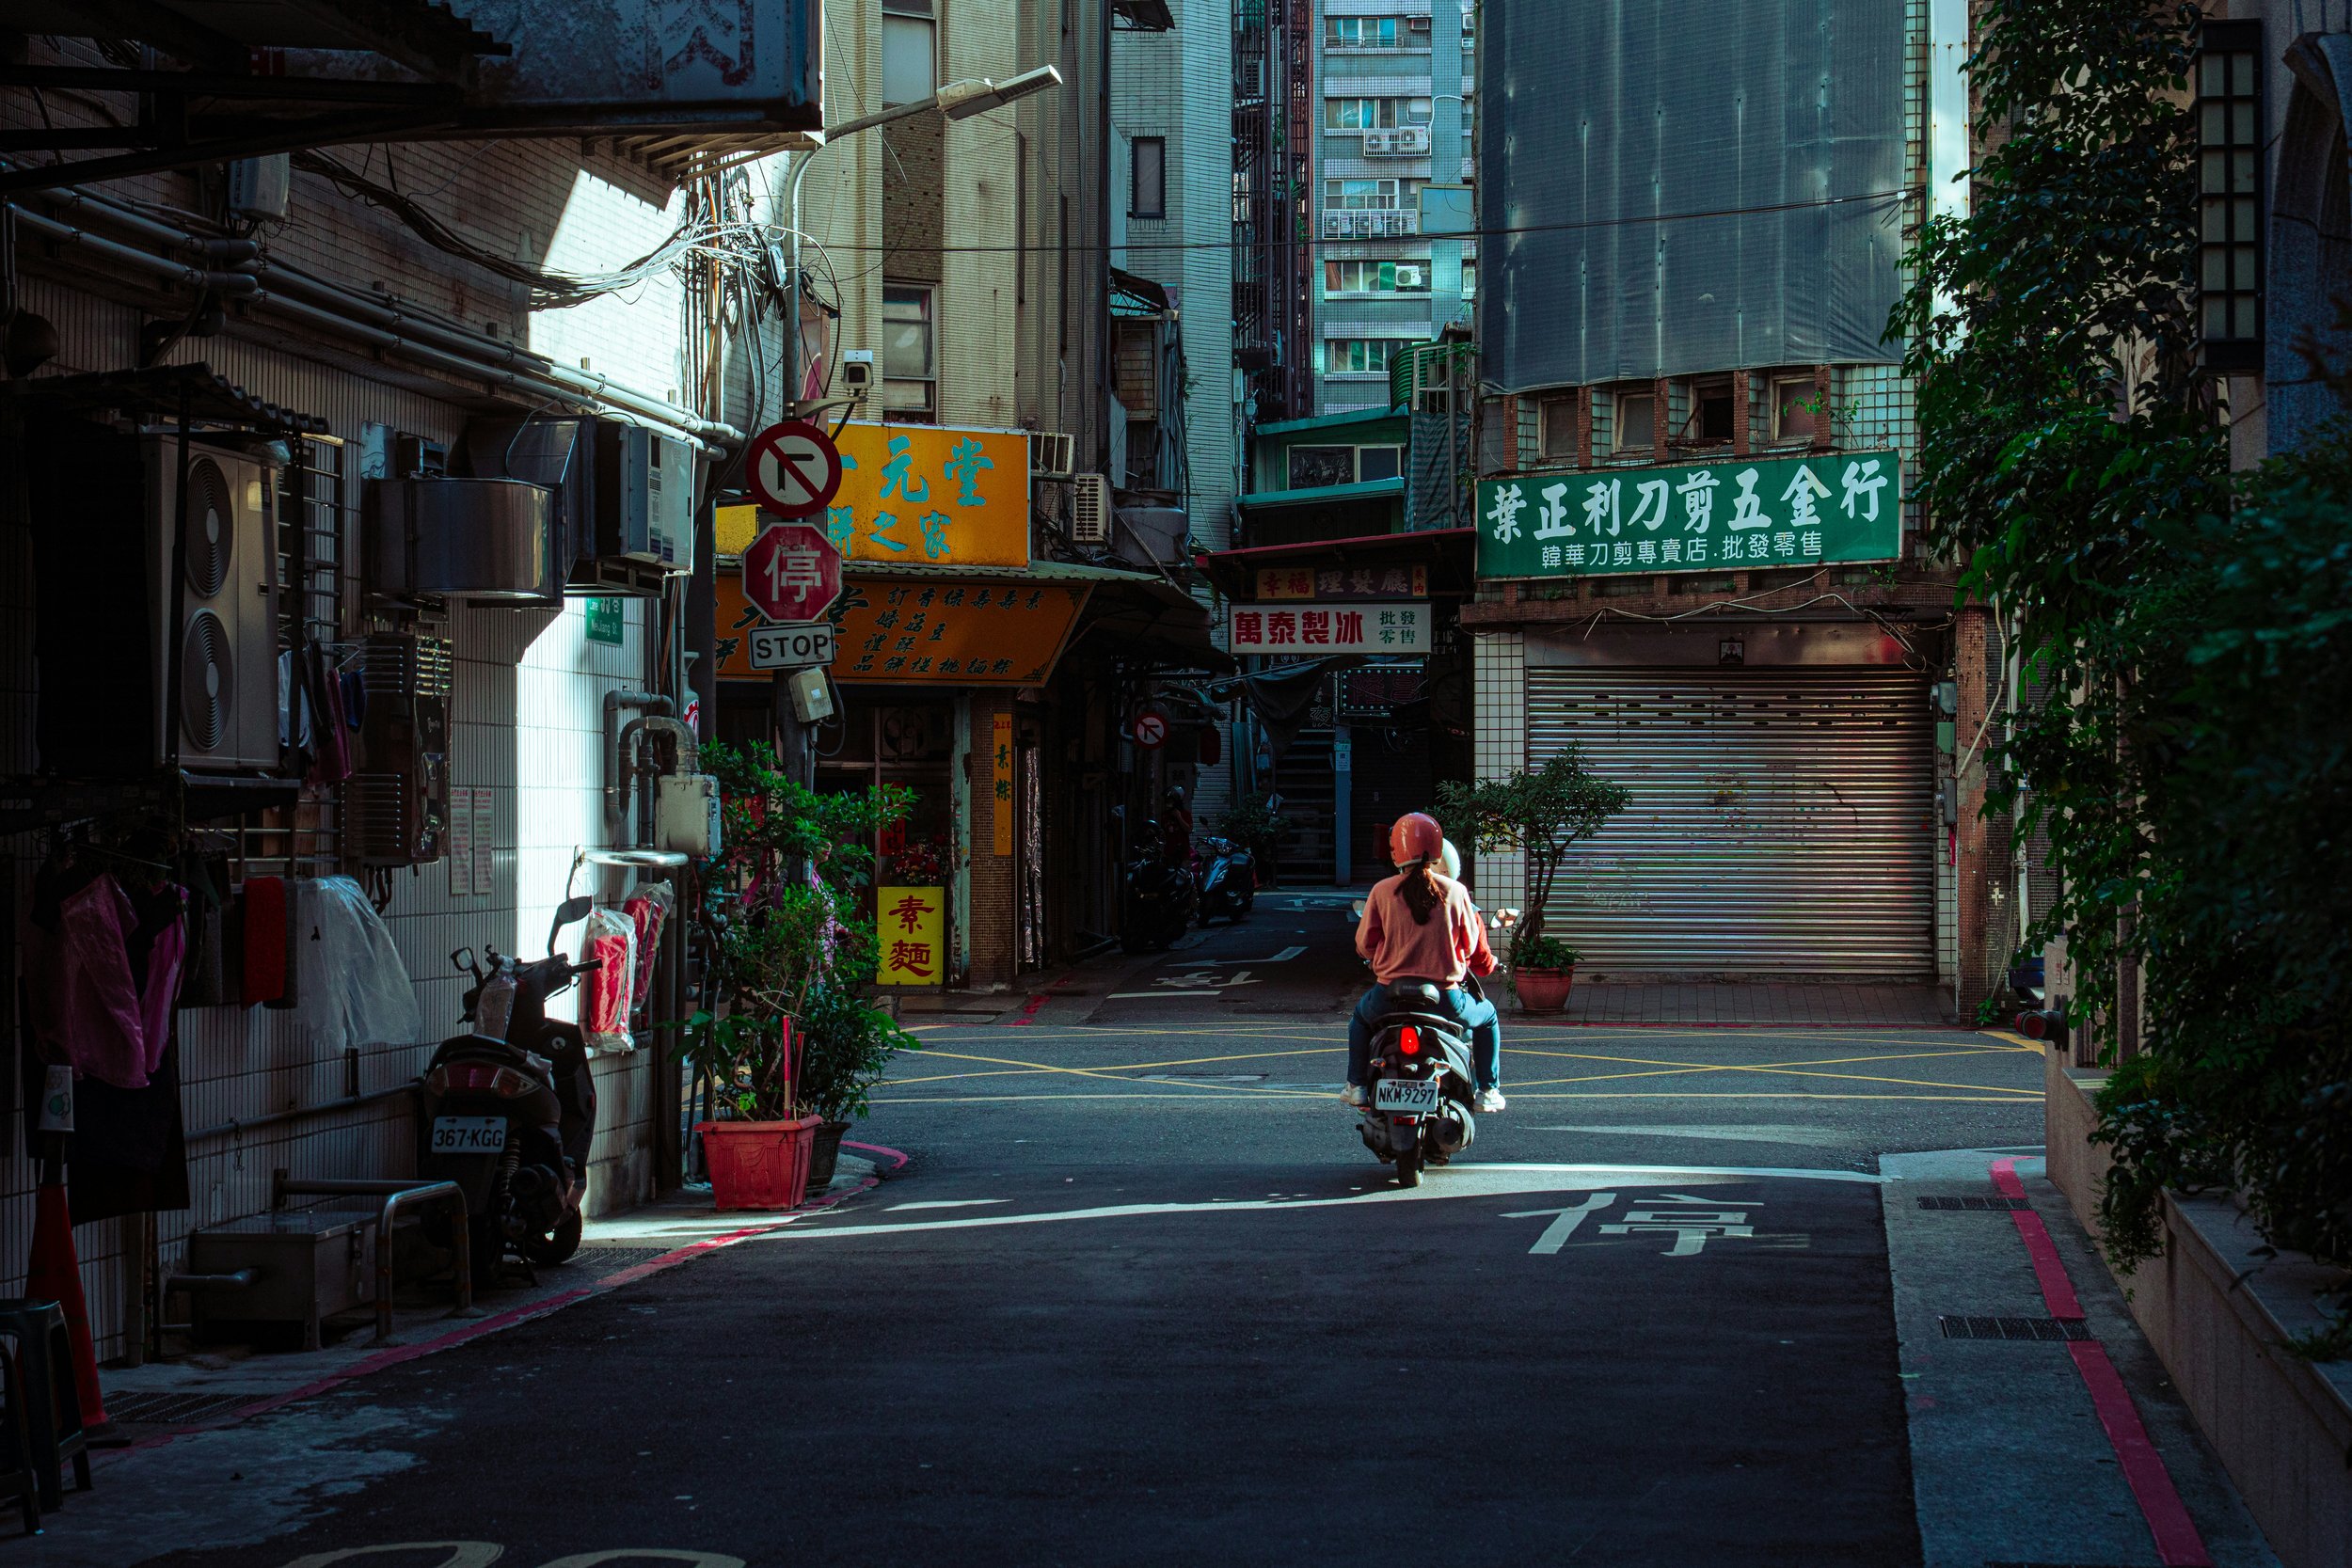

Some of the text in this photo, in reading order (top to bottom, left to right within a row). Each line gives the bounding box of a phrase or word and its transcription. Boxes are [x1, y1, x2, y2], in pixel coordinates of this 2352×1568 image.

[1486, 459, 1889, 545] 葉正利刀剪五金行
[764, 546, 822, 604] 停
[1234, 610, 1364, 644] 萬泰製冰
[1379, 610, 1415, 626] 批發
[1379, 628, 1415, 644] 零售
[756, 633, 829, 659] STOP
[888, 895, 935, 977] 素麵
[1498, 1192, 1765, 1257] 停
